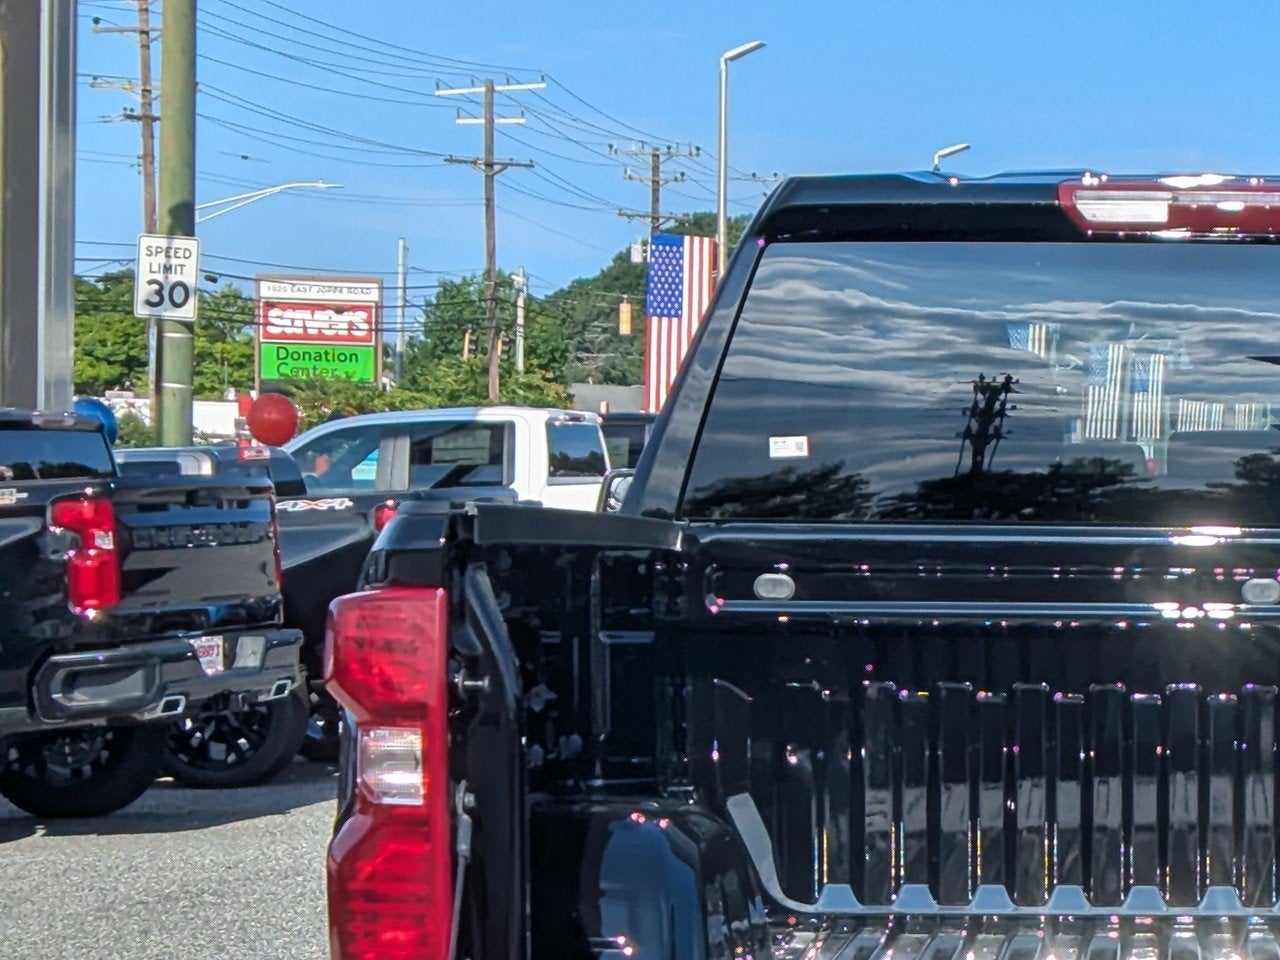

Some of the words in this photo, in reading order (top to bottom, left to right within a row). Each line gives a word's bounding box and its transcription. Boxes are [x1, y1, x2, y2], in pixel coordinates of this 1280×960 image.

[145, 245, 192, 259] SPEED
[149, 262, 186, 275] LIMIT
[144, 278, 190, 309] 30
[290, 285, 312, 293] EAST
[276, 346, 359, 363] Donation
